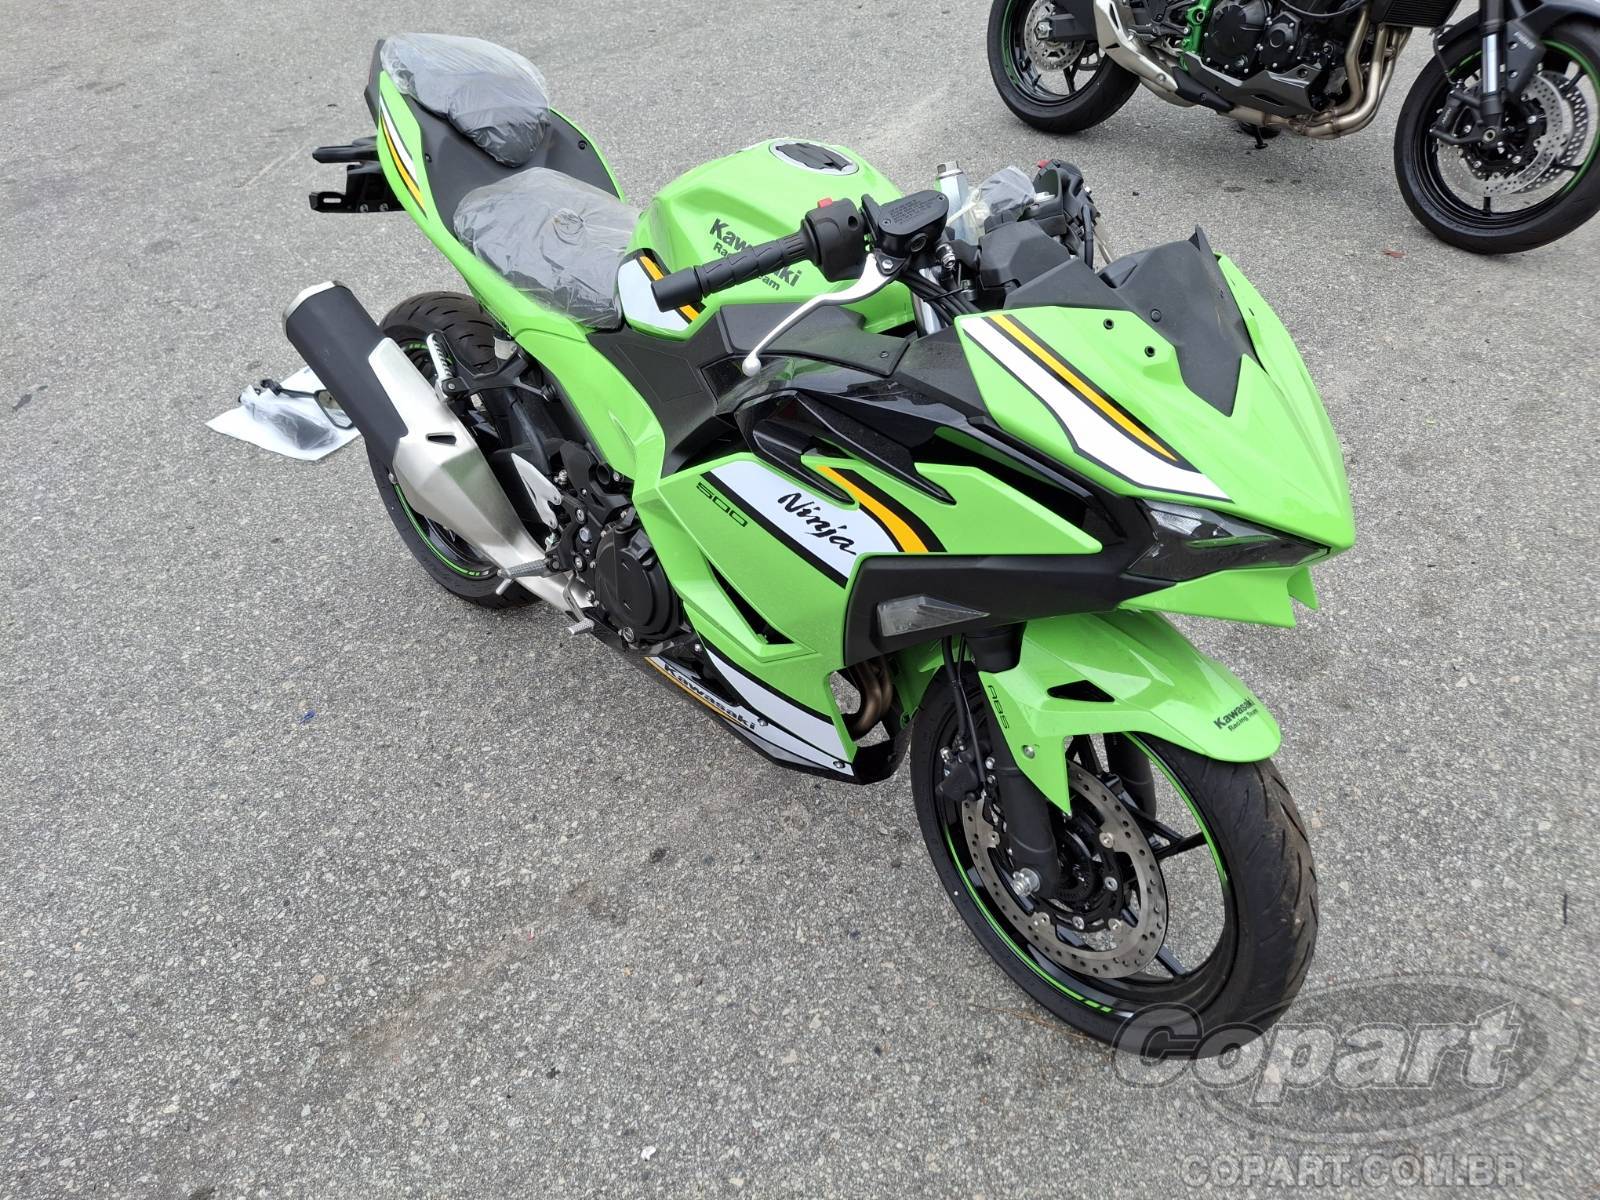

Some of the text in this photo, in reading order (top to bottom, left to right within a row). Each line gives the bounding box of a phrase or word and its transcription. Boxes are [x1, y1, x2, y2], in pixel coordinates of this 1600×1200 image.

[696, 481, 748, 528] 500
[777, 492, 857, 556] Ninja
[664, 663, 756, 730] Kawasaki
[987, 684, 1010, 729] ABS
[1213, 696, 1256, 730] Kawasaki
[1227, 715, 1250, 732] Racing
